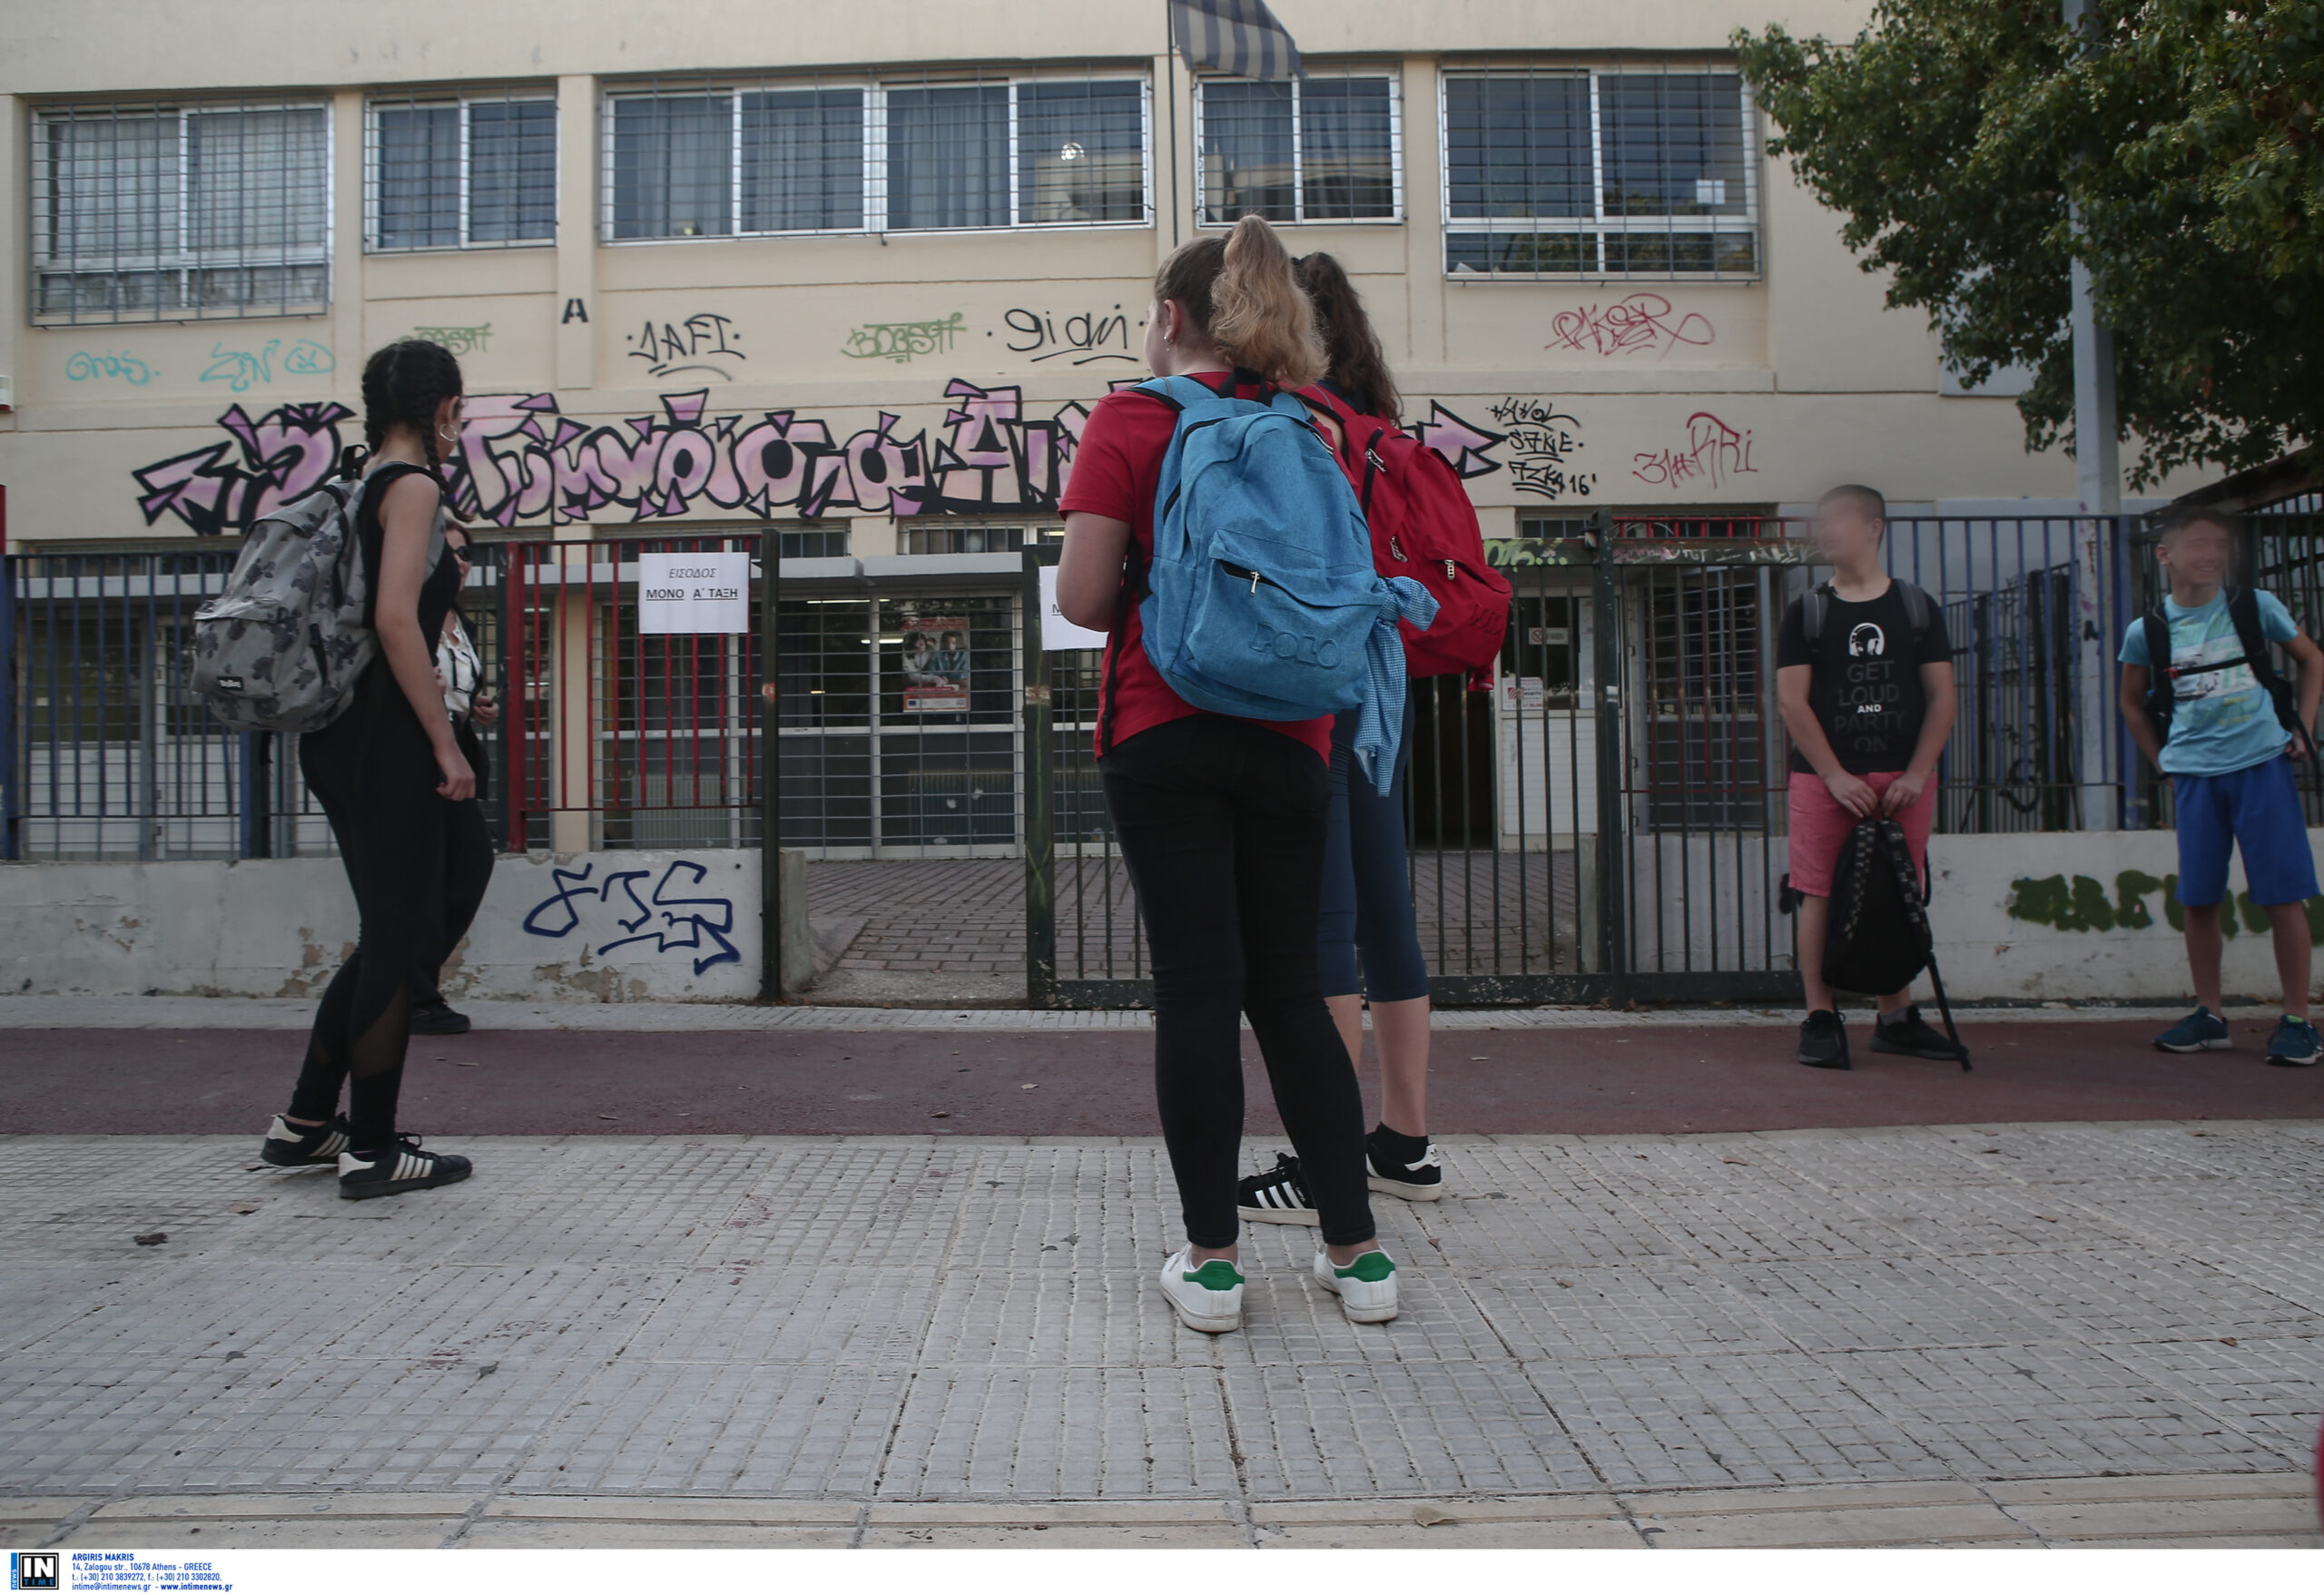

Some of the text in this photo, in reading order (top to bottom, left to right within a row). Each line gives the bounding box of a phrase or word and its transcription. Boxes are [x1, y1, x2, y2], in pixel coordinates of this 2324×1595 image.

[668, 567, 717, 579] ΕΙΣΟΔΟΣ
[645, 588, 684, 599] ΜΟΝΟ
[708, 587, 738, 598] ΤΑΞΗ
[1846, 660, 1896, 684] GET
[1837, 684, 1900, 706] LOUD
[1856, 704, 1883, 714] AND
[1834, 710, 1905, 734] PARTY
